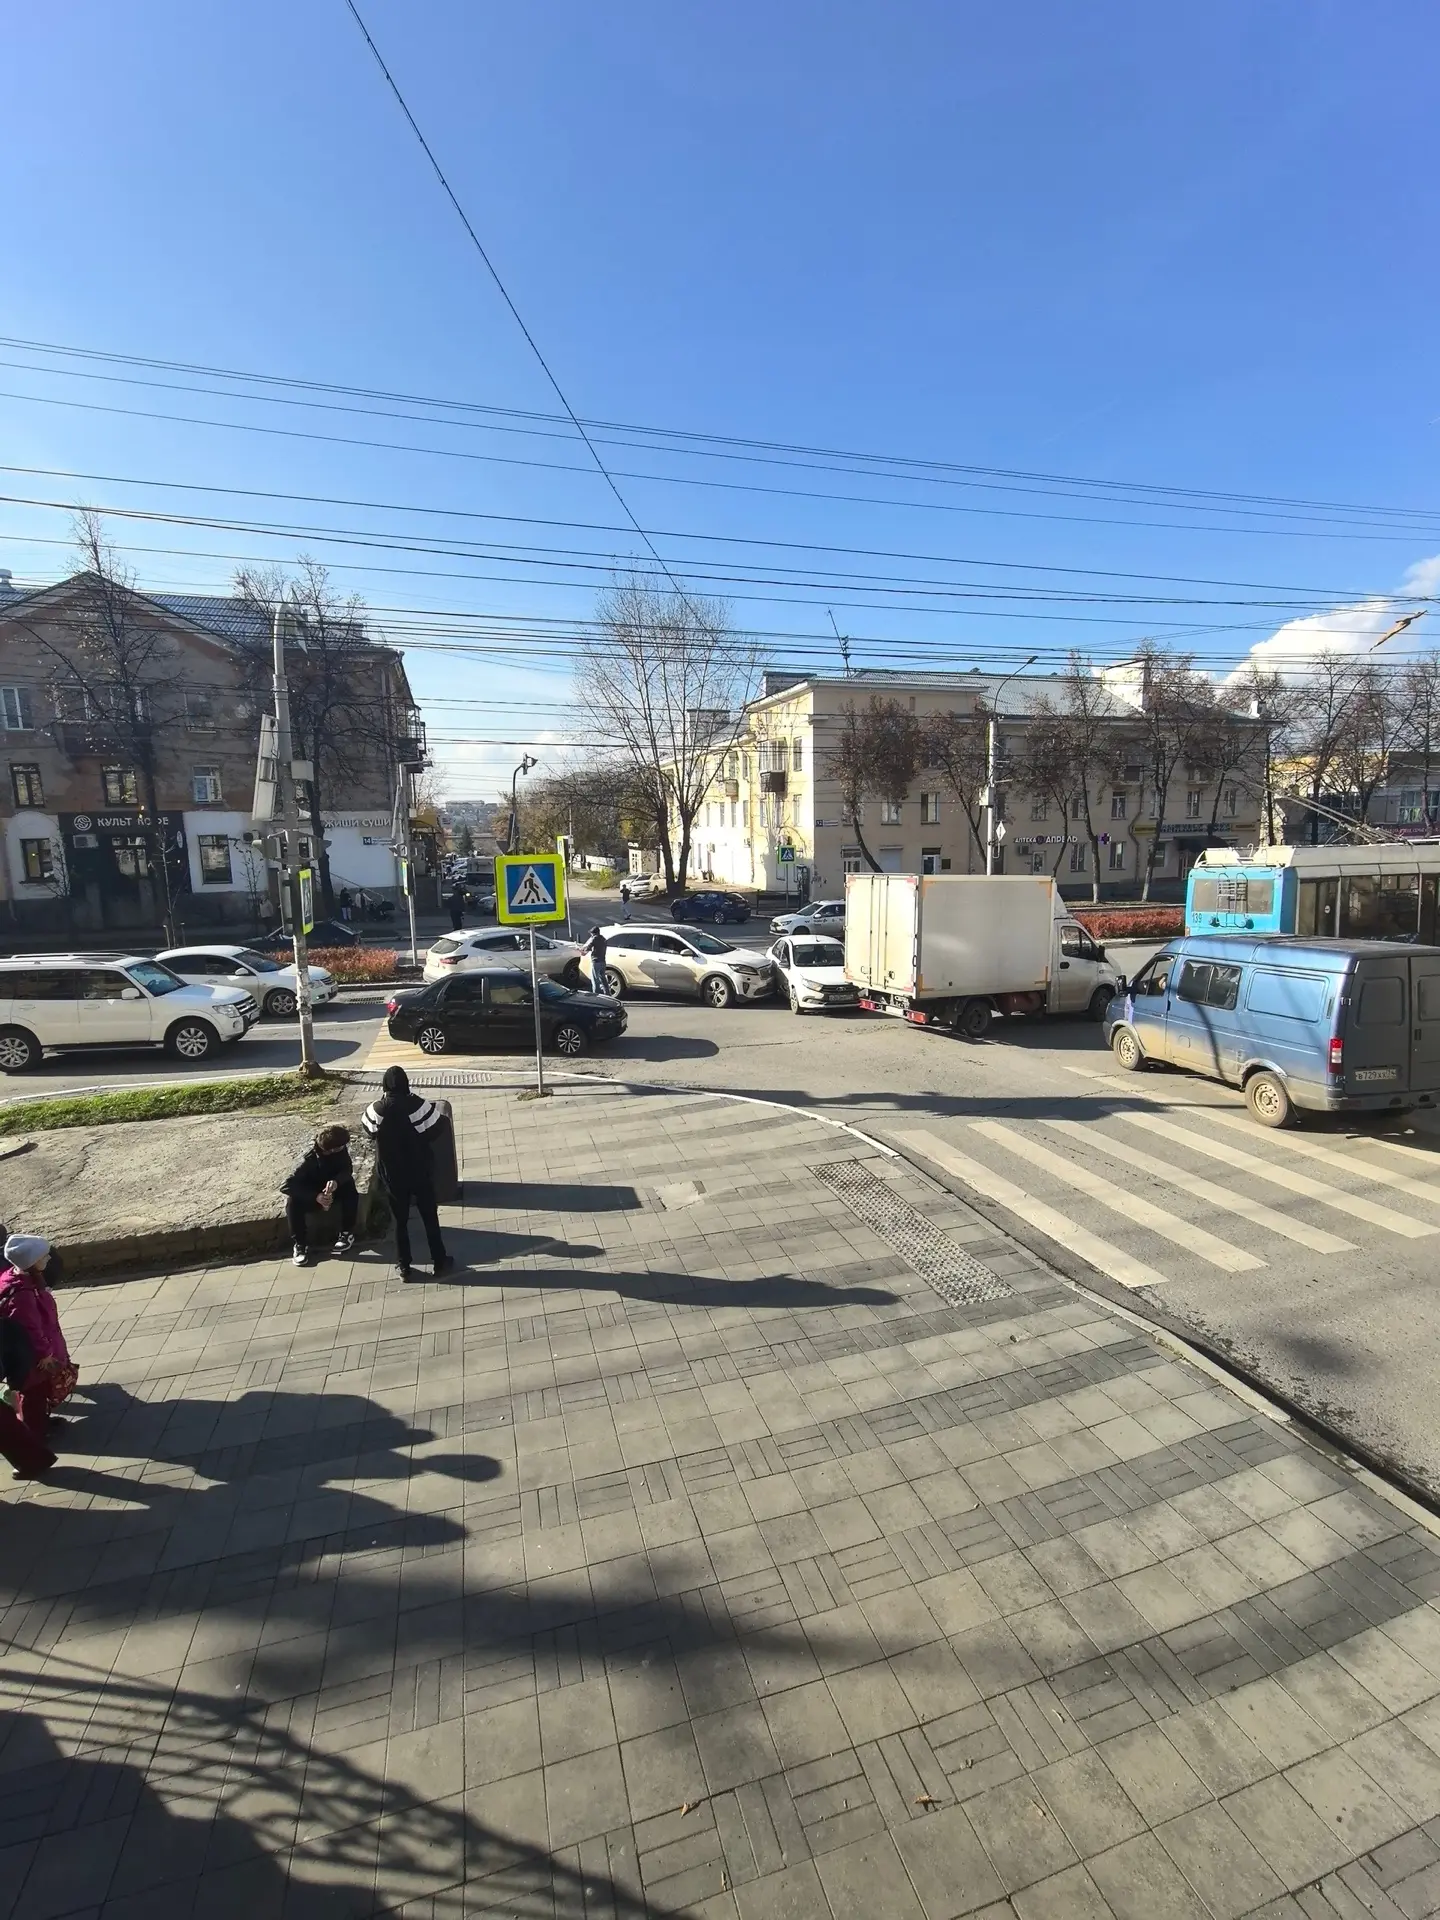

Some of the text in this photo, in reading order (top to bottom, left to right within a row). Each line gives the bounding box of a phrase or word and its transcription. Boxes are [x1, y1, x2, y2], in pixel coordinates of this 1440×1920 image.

[97, 816, 169, 827] КУЛЬТ КОЕ
[361, 817, 391, 828] СУШИ
[1045, 835, 1078, 843] АПРЕЛЬ
[1192, 913, 1203, 923] 139
